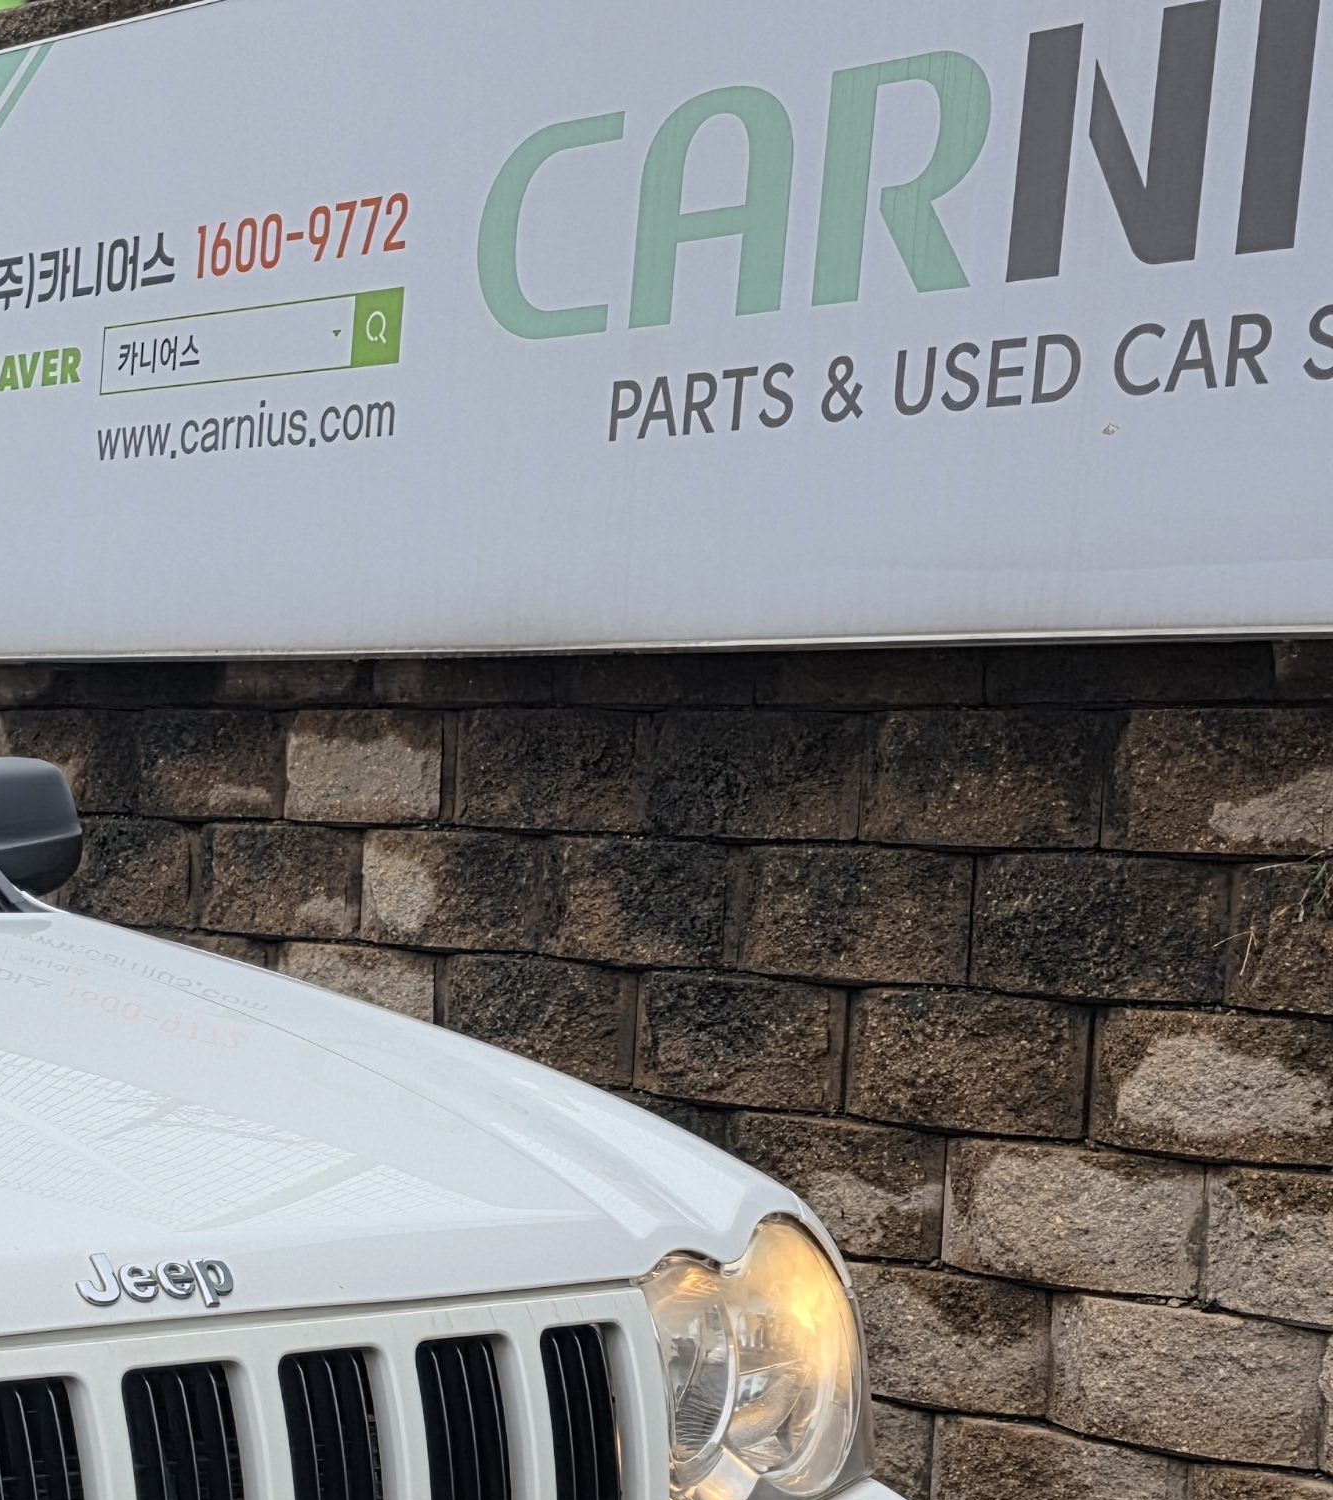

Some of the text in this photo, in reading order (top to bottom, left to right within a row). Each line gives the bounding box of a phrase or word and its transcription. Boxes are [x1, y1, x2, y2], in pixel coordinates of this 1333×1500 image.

[196, 192, 409, 279] 1600-9772
[117, 334, 201, 377] 카니어스
[607, 362, 795, 443] PARTS
[821, 354, 864, 424] &
[893, 333, 1082, 417] USED
[1113, 312, 1273, 397] CAR
[97, 400, 396, 461] www.carnius.com
[76, 1252, 235, 1308] Jeep
